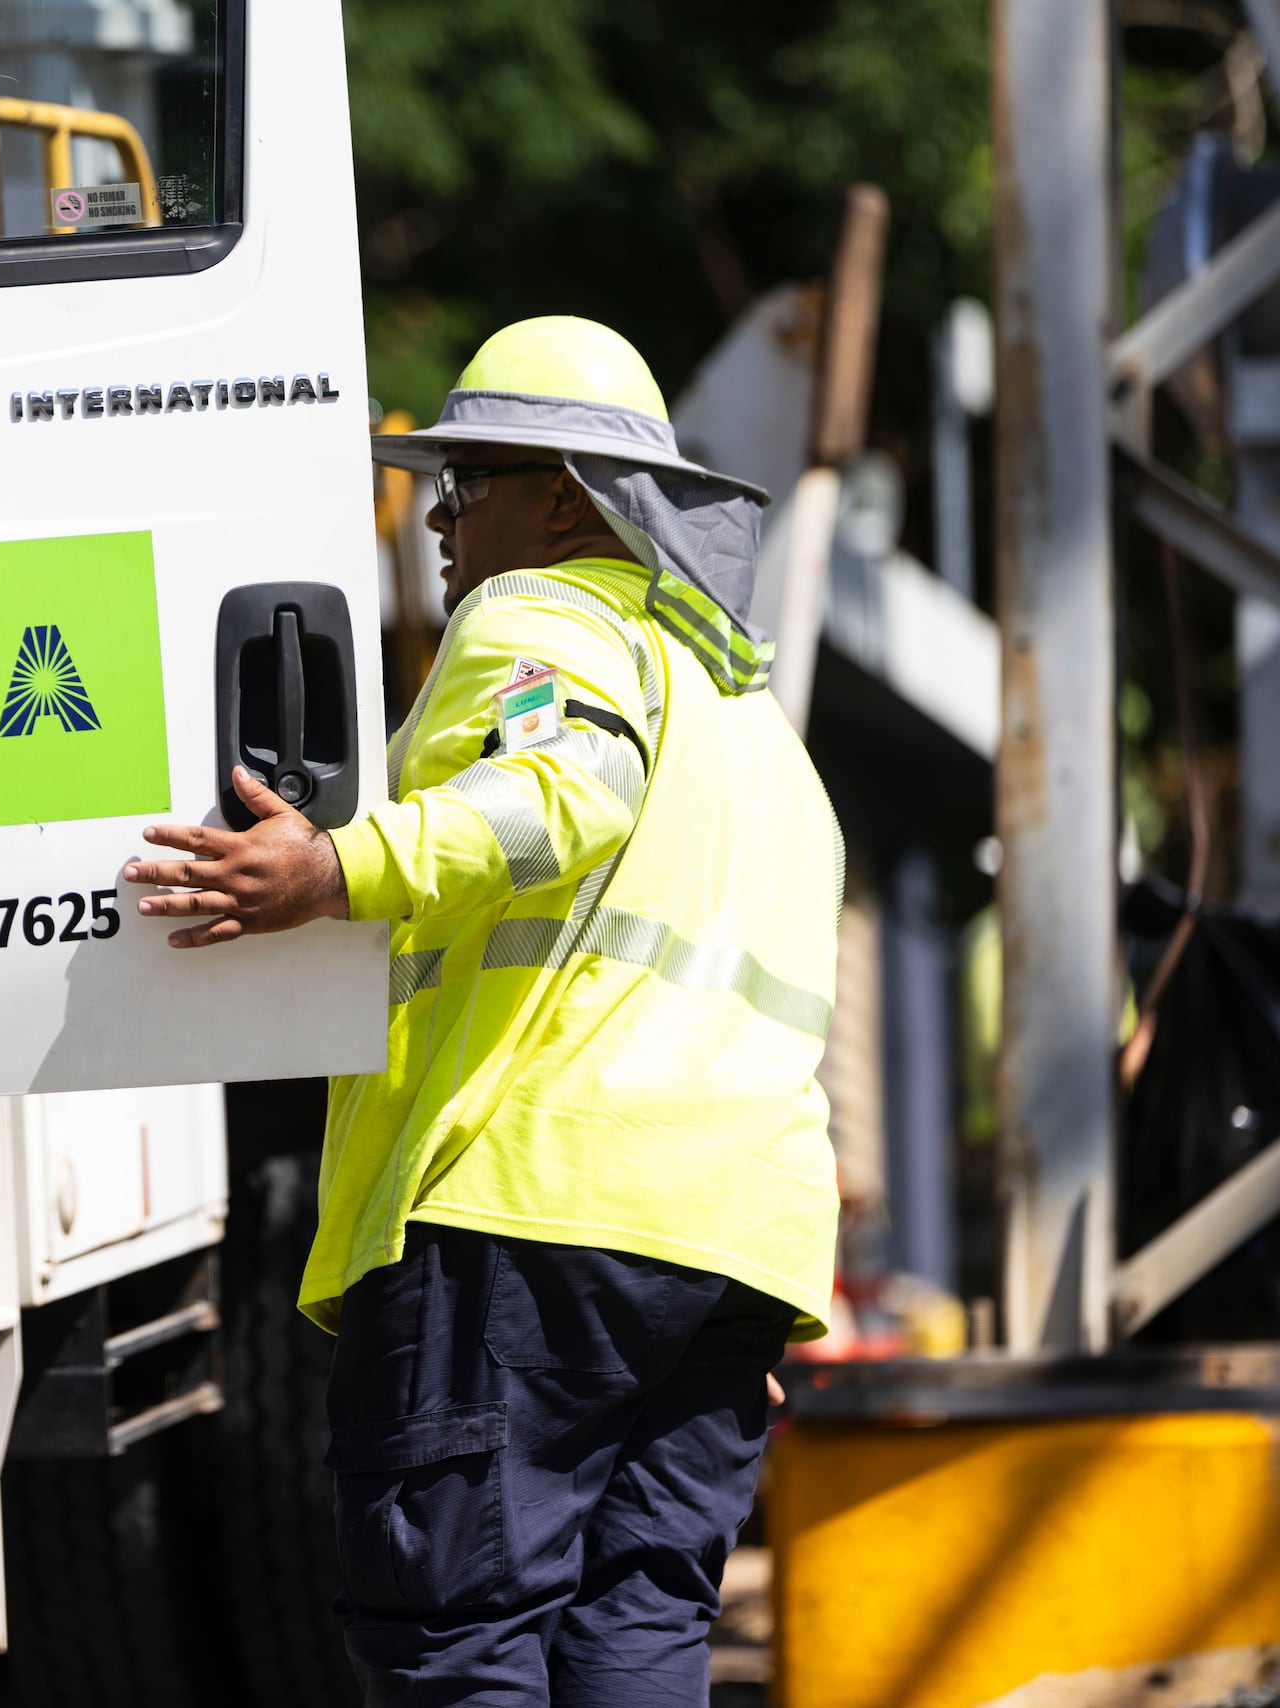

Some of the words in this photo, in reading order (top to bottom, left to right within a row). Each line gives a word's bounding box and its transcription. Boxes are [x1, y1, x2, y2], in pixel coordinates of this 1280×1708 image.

[87, 192, 98, 203] NO
[99, 190, 126, 203] FUMAR
[88, 207, 100, 218] NO
[100, 205, 136, 217] SMOKING
[12, 371, 340, 421] INTERNATIONAL
